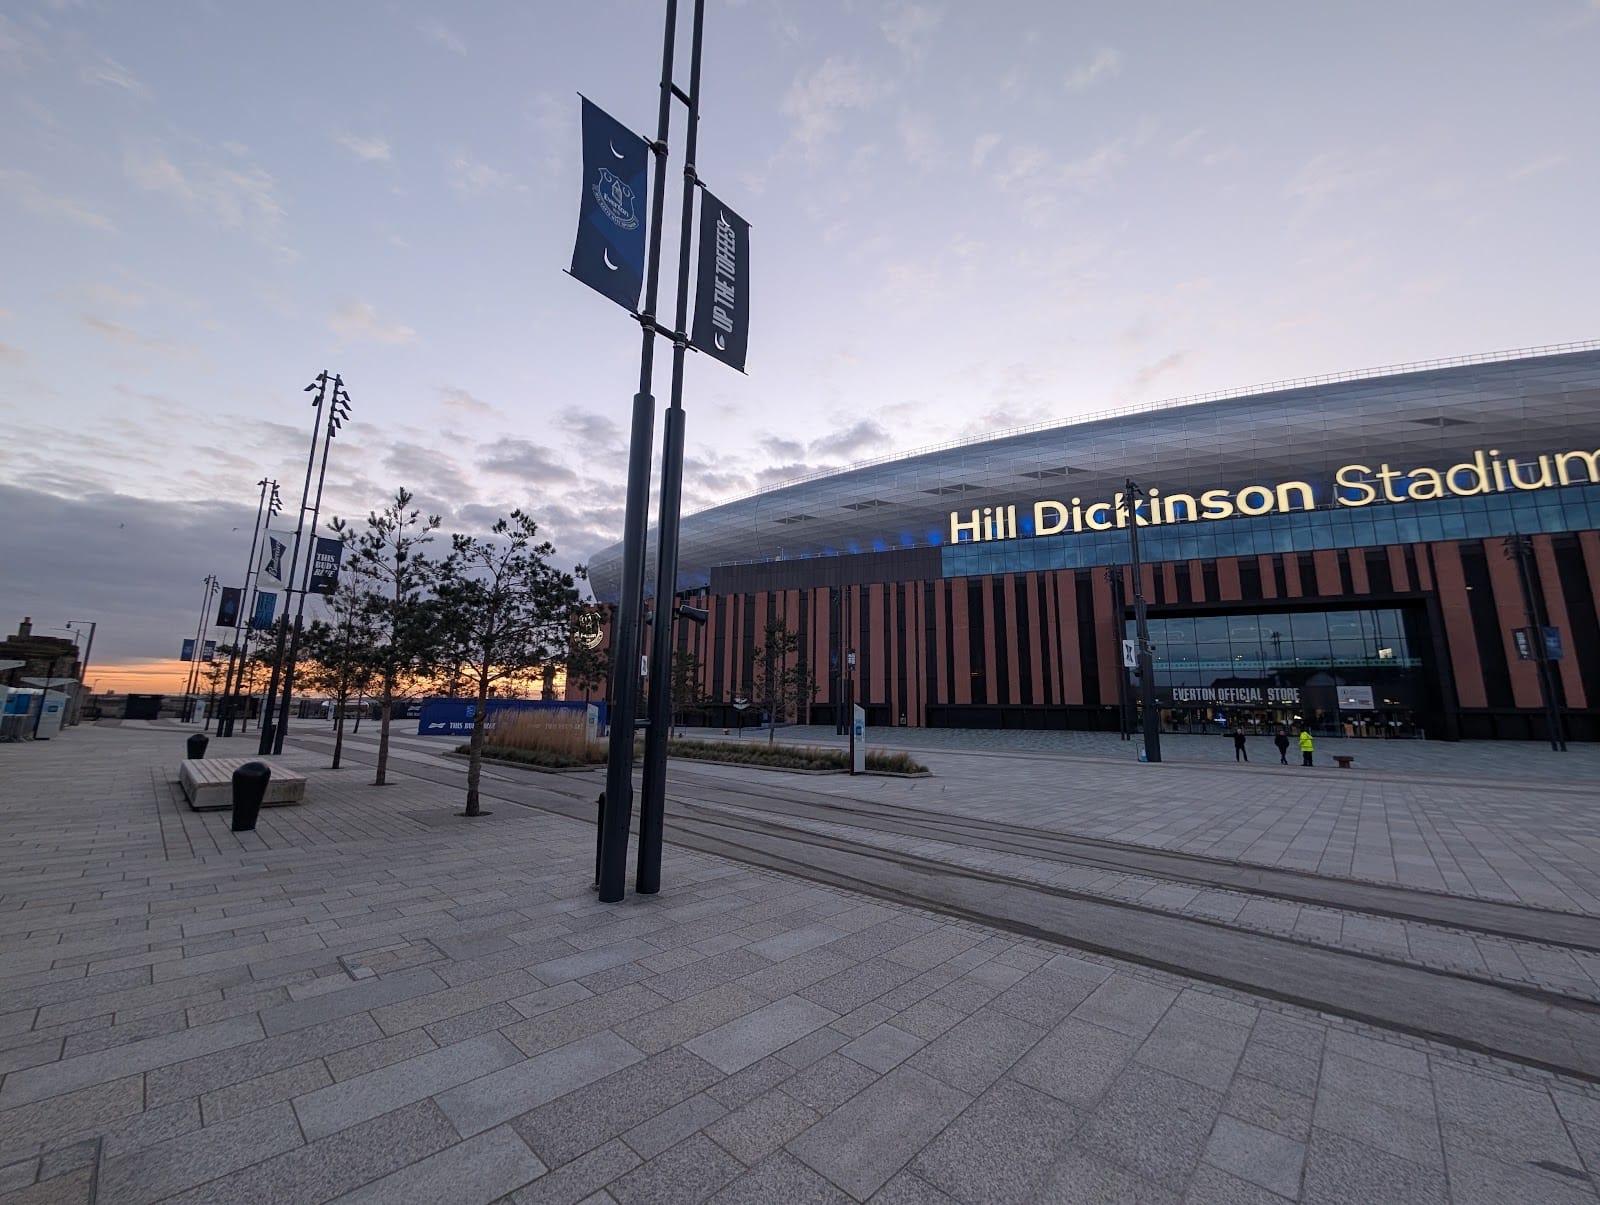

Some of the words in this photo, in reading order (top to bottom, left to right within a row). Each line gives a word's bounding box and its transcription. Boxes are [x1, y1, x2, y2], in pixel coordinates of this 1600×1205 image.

[716, 219, 736, 281] TOFFEES
[714, 275, 735, 310] THE
[712, 305, 733, 333] UP
[950, 503, 1017, 544] Hill
[1033, 481, 1315, 536] Dickinson
[1335, 448, 1600, 507] Stadium
[315, 561, 338, 571] BUD'S
[316, 553, 336, 562] THIS
[1172, 687, 1216, 701] EVERTON
[1218, 687, 1263, 701] OFFICIAL
[1267, 687, 1300, 701] STORE
